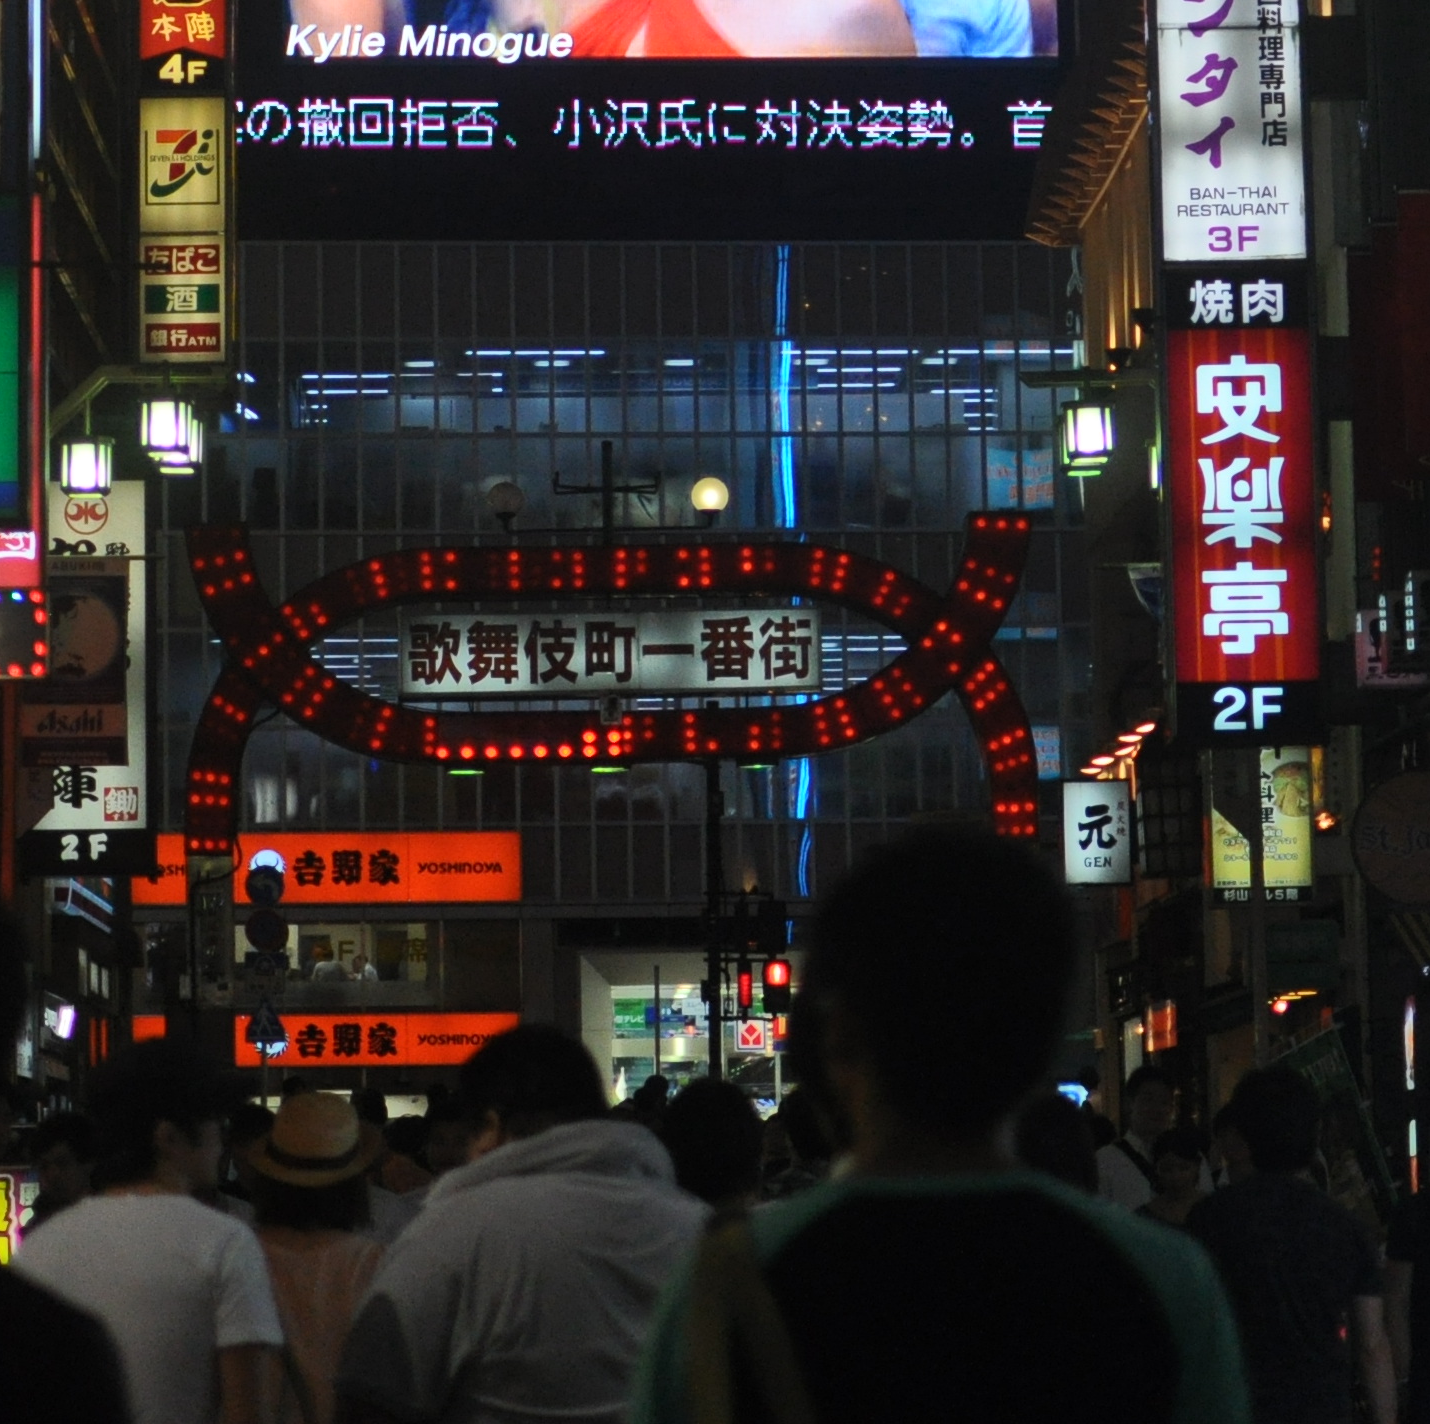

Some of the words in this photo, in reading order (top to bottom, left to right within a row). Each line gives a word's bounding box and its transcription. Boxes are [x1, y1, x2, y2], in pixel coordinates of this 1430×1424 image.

[151, 11, 217, 43] 本陣
[285, 24, 386, 65] Kylie
[397, 28, 574, 63] Minogue
[159, 53, 208, 84] 4F
[236, 98, 1054, 149] の撤回拒否、小沢氏に対決姿勢。首
[1189, 185, 1278, 201] BAN-THAI
[1177, 201, 1290, 218] RESTAURANT
[1207, 225, 1260, 253] 3F
[166, 285, 199, 312] 酒
[1189, 279, 1284, 325] 焼肉
[1195, 353, 1290, 656] 安楽亭
[409, 619, 813, 684] 歌舞伎町一番街
[1212, 686, 1285, 732] 2F
[1077, 803, 1118, 851] 元
[60, 833, 109, 862] 2F
[1083, 856, 1113, 869] GEN
[417, 860, 503, 875] YOSHINOYA
[417, 1032, 501, 1046] YOSHINOY
